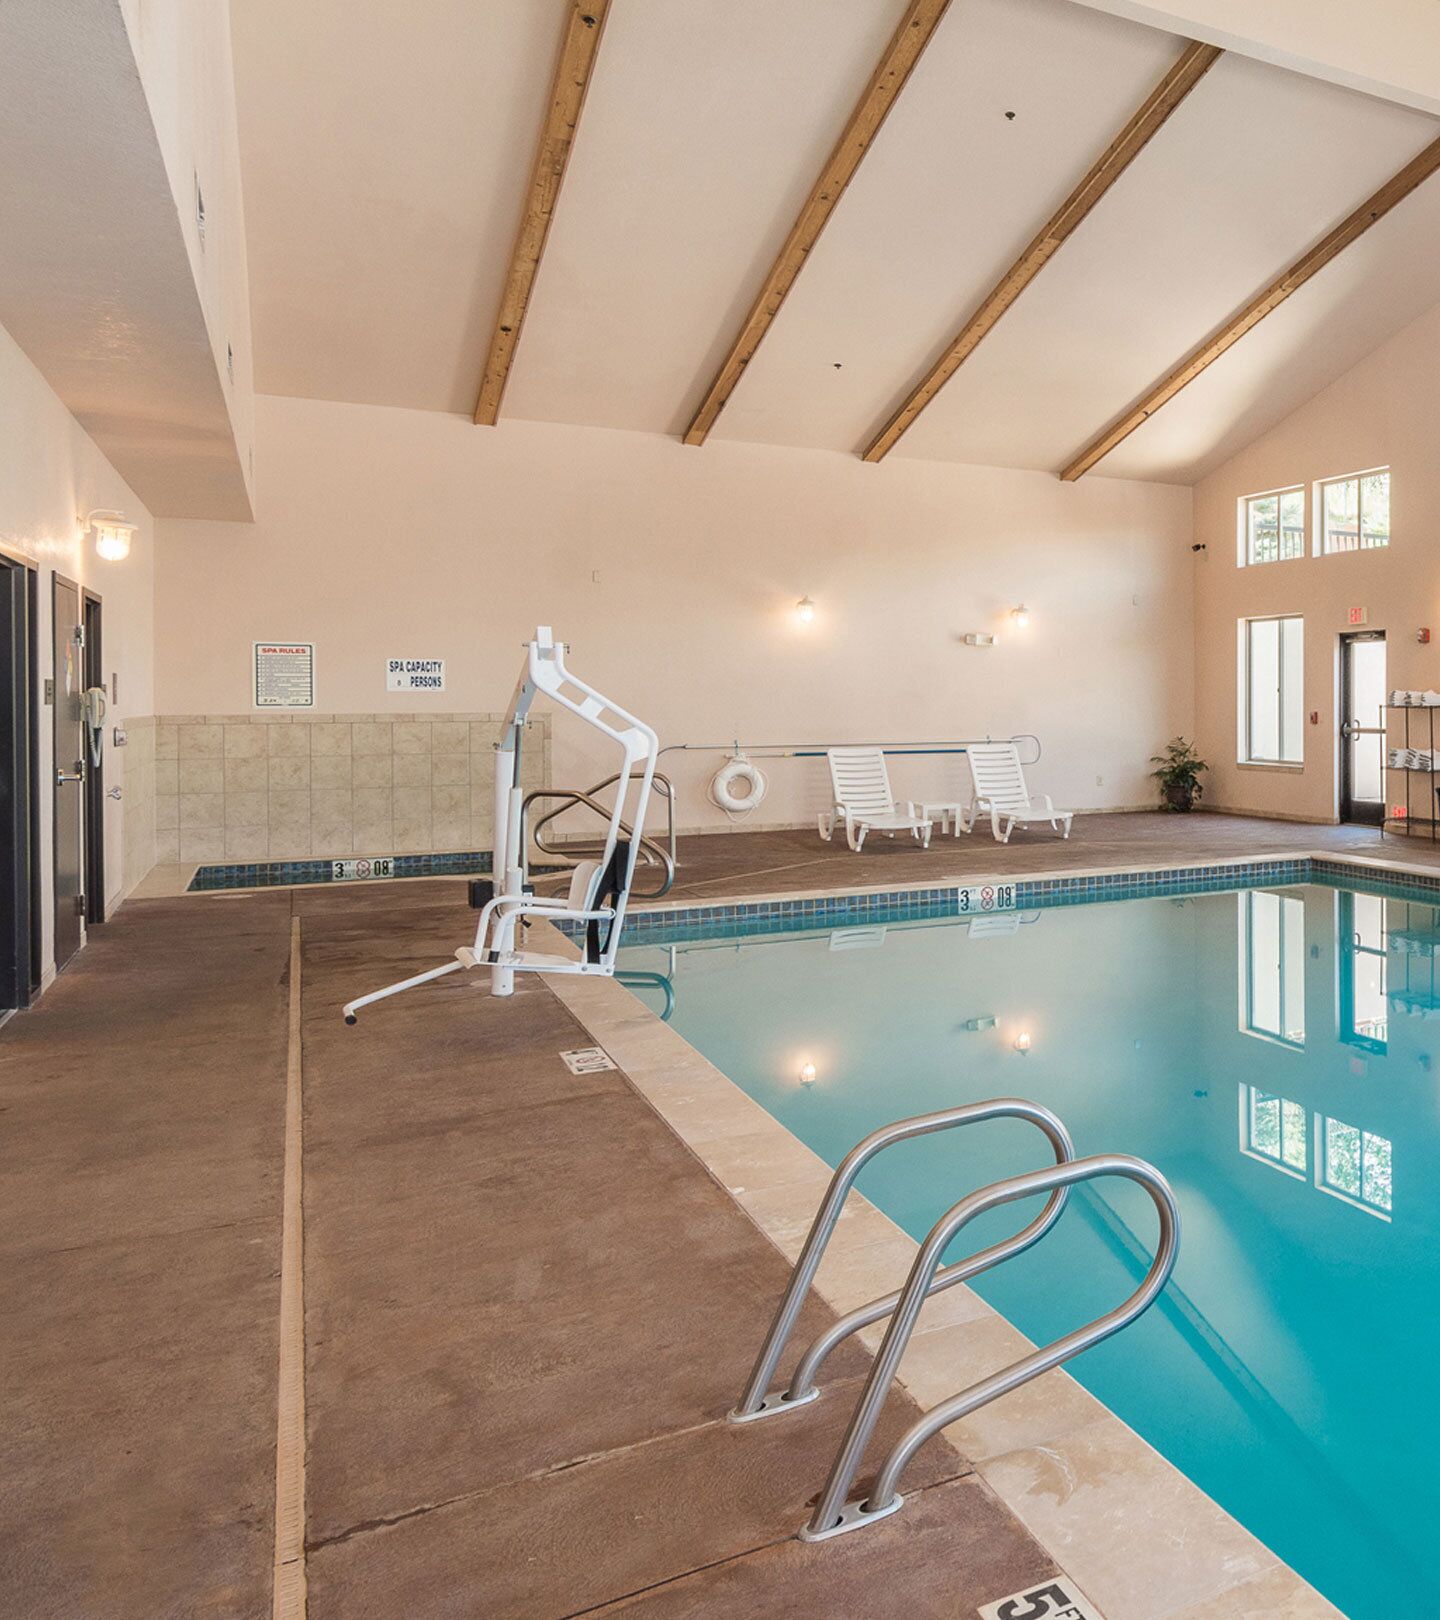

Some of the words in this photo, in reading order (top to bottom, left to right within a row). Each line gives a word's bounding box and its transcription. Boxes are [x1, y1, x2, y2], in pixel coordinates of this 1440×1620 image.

[389, 661, 404, 672] SPA
[406, 661, 442, 672] CAPACITY
[411, 676, 441, 687] PERSONS
[997, 1584, 1072, 1620] 5
